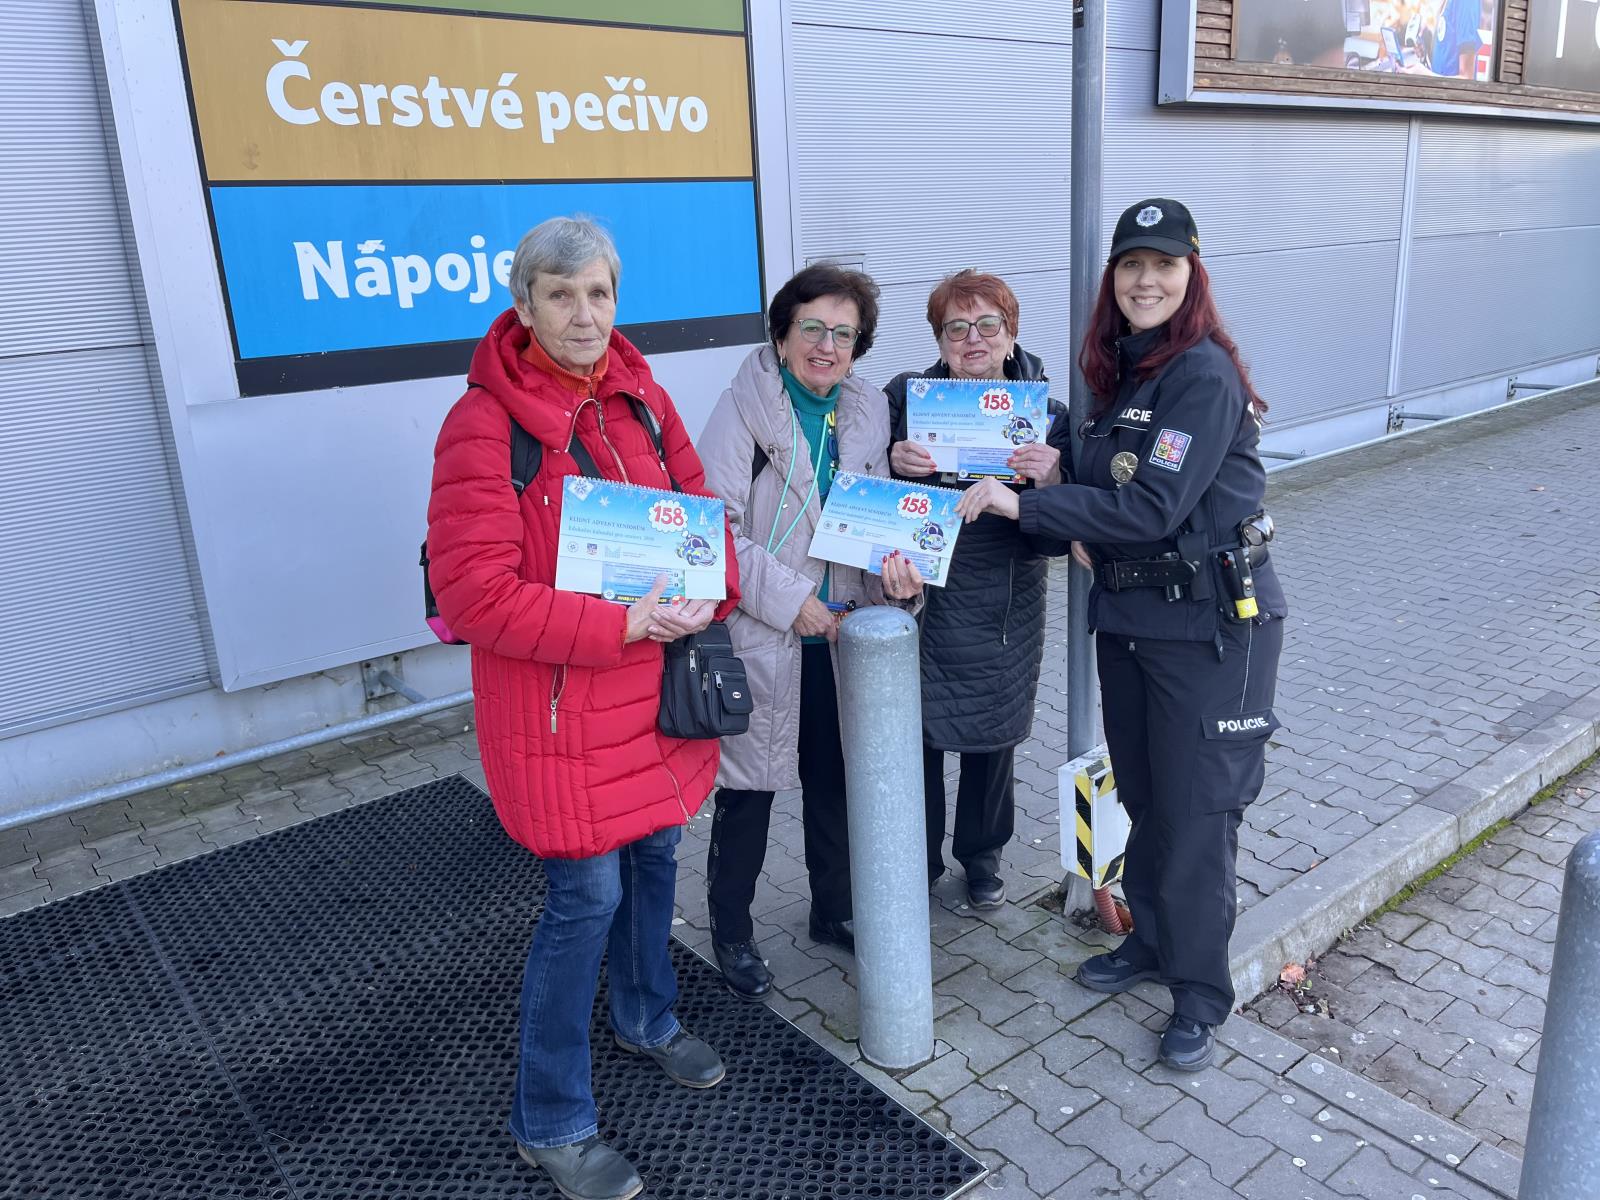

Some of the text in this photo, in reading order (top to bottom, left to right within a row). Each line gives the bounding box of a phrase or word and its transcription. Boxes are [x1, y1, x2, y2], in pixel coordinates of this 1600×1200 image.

[265, 38, 709, 144] Čerstvé pečivo
[293, 235, 516, 309] Nápoje
[982, 393, 1011, 411] 158
[1117, 407, 1153, 422] LICIE
[1152, 456, 1179, 469] POLICIE
[901, 496, 929, 515] 158
[653, 505, 684, 527] 158
[1217, 717, 1269, 733] POLICIE
